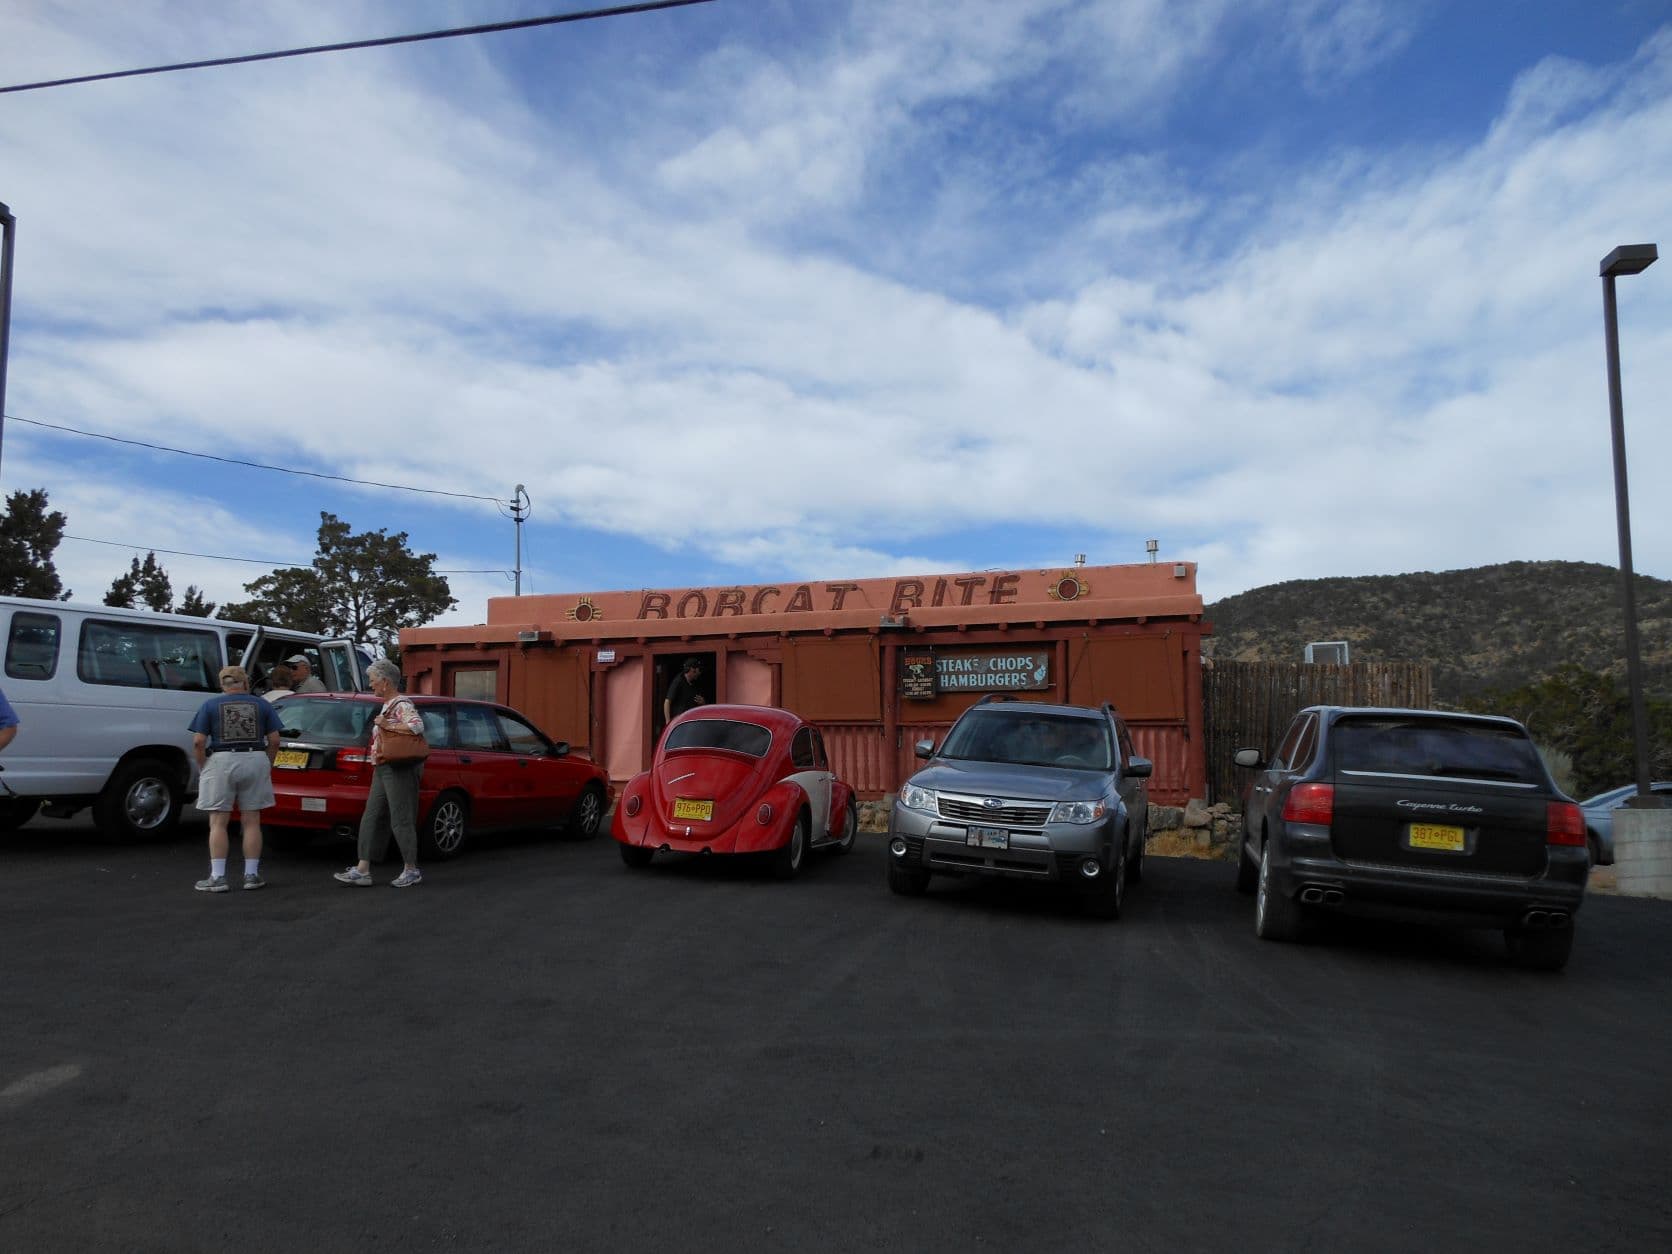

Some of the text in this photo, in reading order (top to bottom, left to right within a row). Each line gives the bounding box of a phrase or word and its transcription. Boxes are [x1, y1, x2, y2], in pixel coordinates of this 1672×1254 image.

[636, 574, 1021, 620] BOBCAT BITE
[989, 656, 1034, 671] CHOPS
[940, 672, 1028, 687] HAMBURGERS
[1396, 799, 1447, 811] Cayenne
